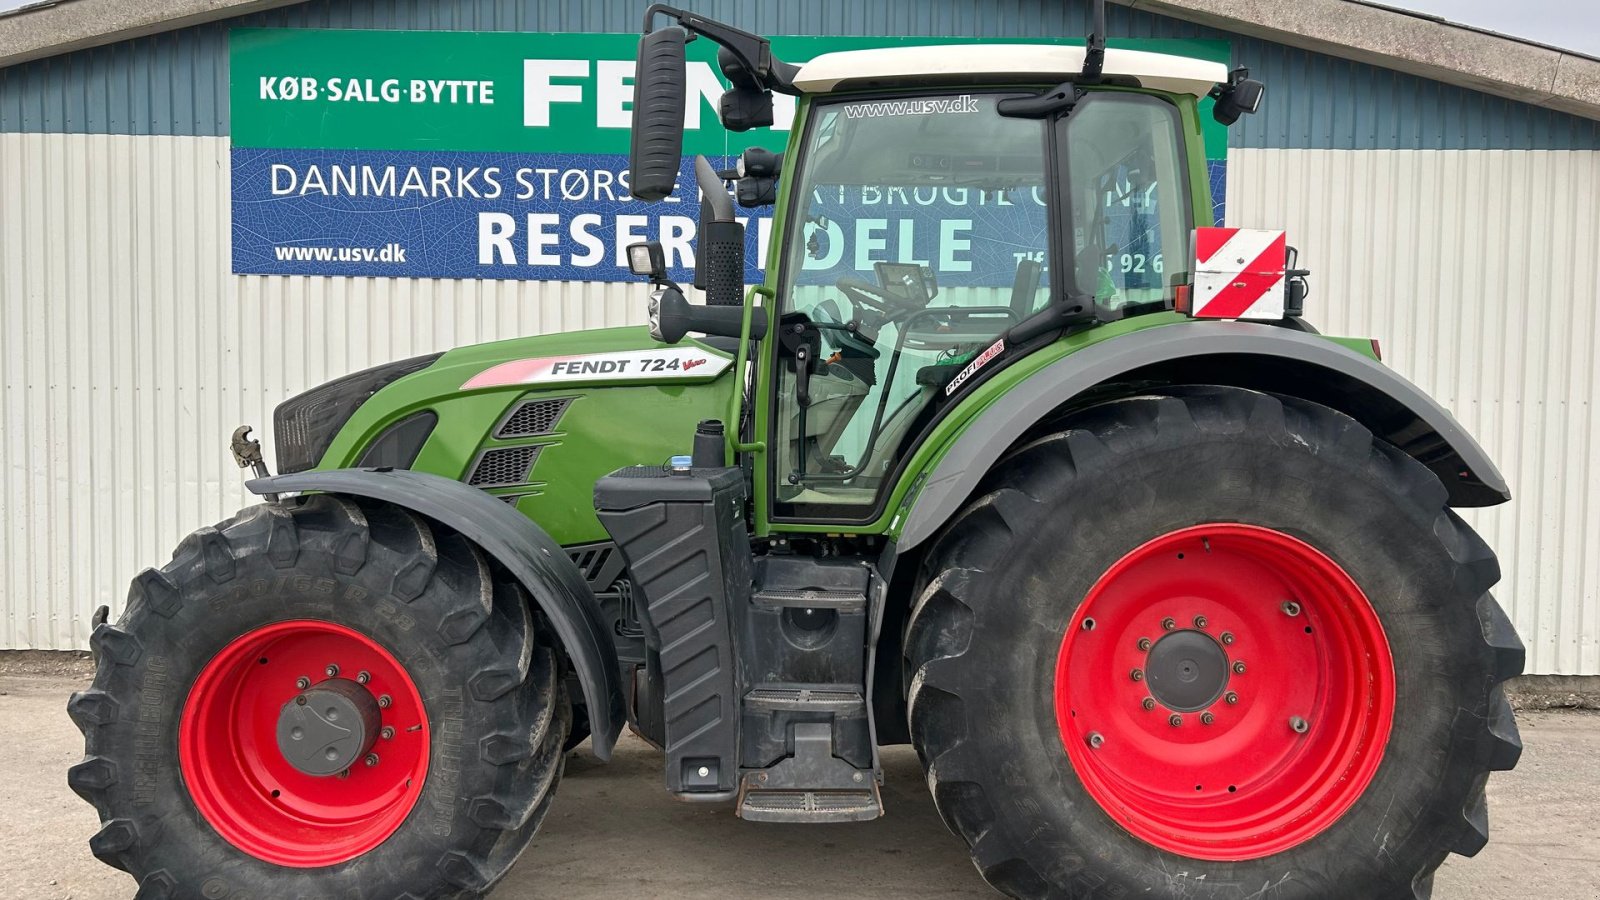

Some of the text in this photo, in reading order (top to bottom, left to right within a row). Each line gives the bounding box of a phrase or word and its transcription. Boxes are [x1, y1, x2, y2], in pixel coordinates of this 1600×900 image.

[844, 95, 979, 119] www.usv.dk
[271, 164, 502, 199] DANMARKS
[275, 242, 406, 263] www.usv.dk
[478, 212, 973, 272] RESERDELE
[1120, 253, 1146, 273] 92
[551, 359, 631, 375] FENDT
[640, 358, 680, 372] 724
